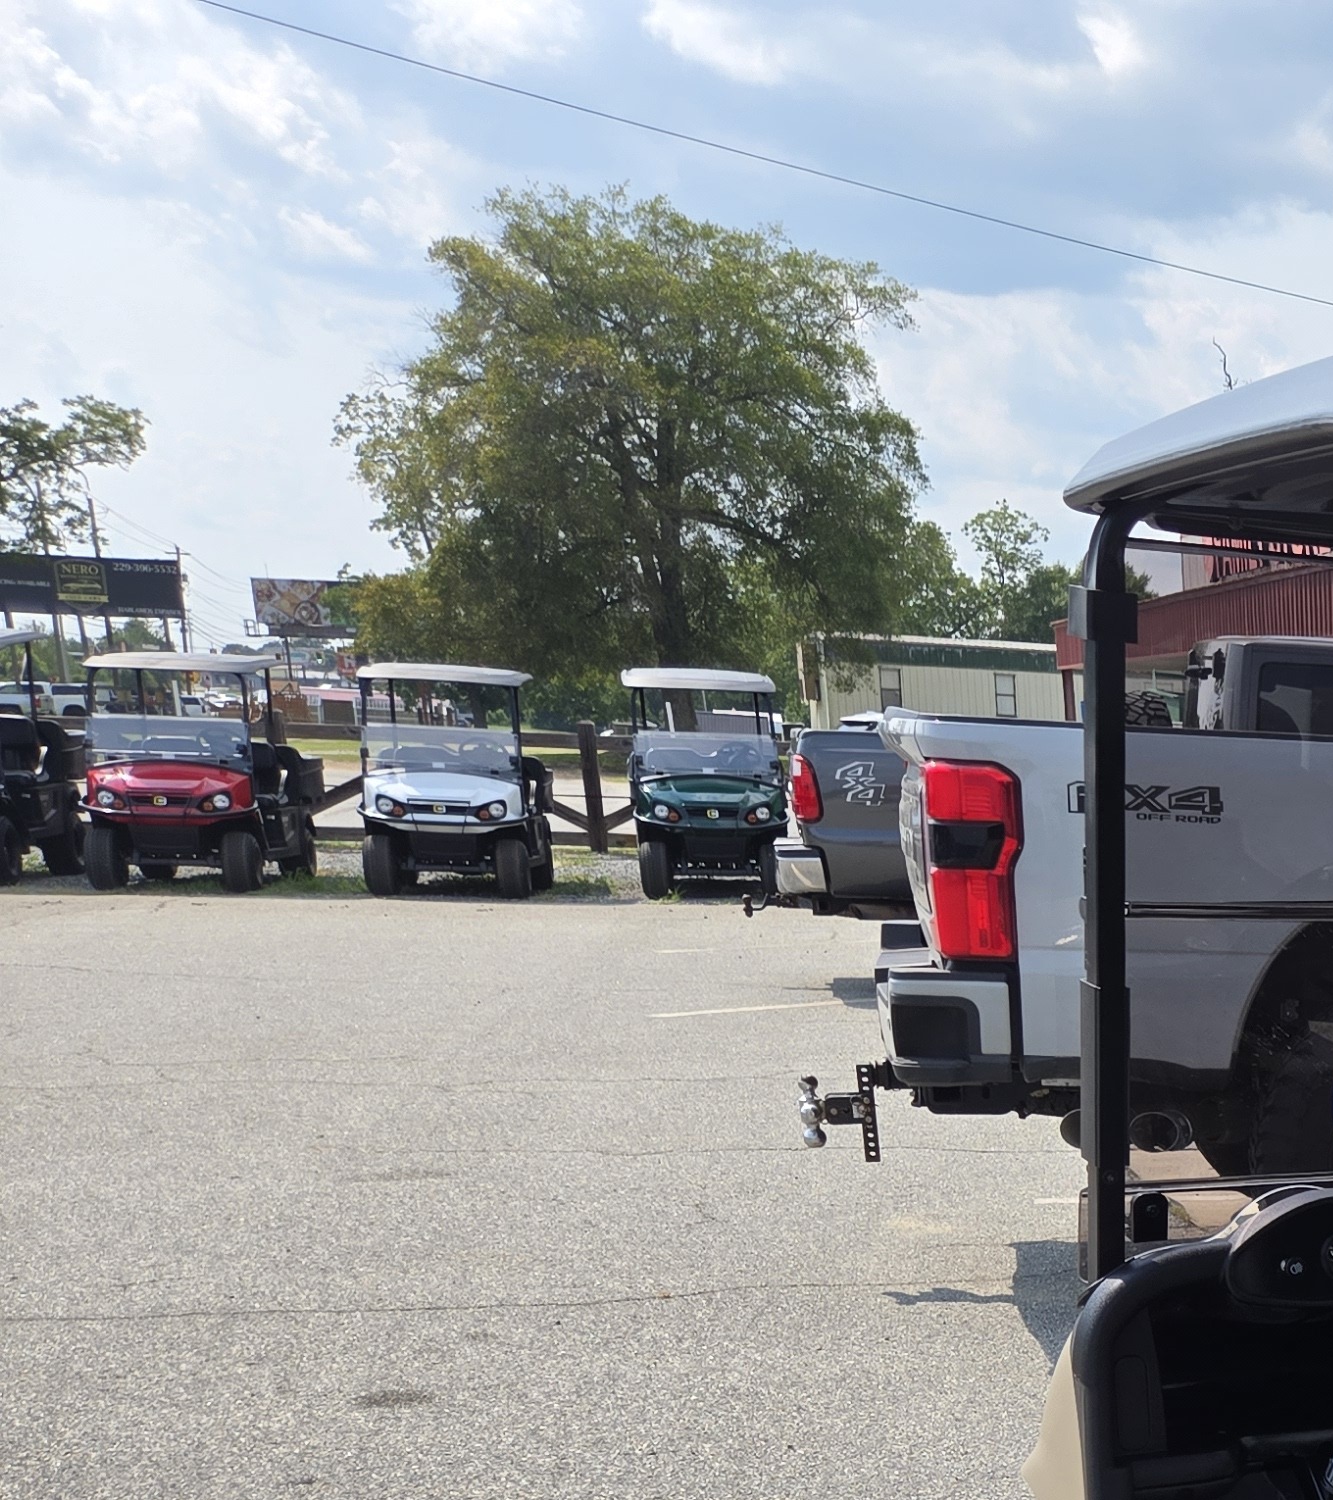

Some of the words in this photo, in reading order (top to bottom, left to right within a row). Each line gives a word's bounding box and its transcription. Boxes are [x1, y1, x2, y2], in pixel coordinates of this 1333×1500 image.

[61, 563, 99, 576] NERO
[1136, 812, 1171, 821] OFF
[1175, 815, 1221, 824] ROAD
